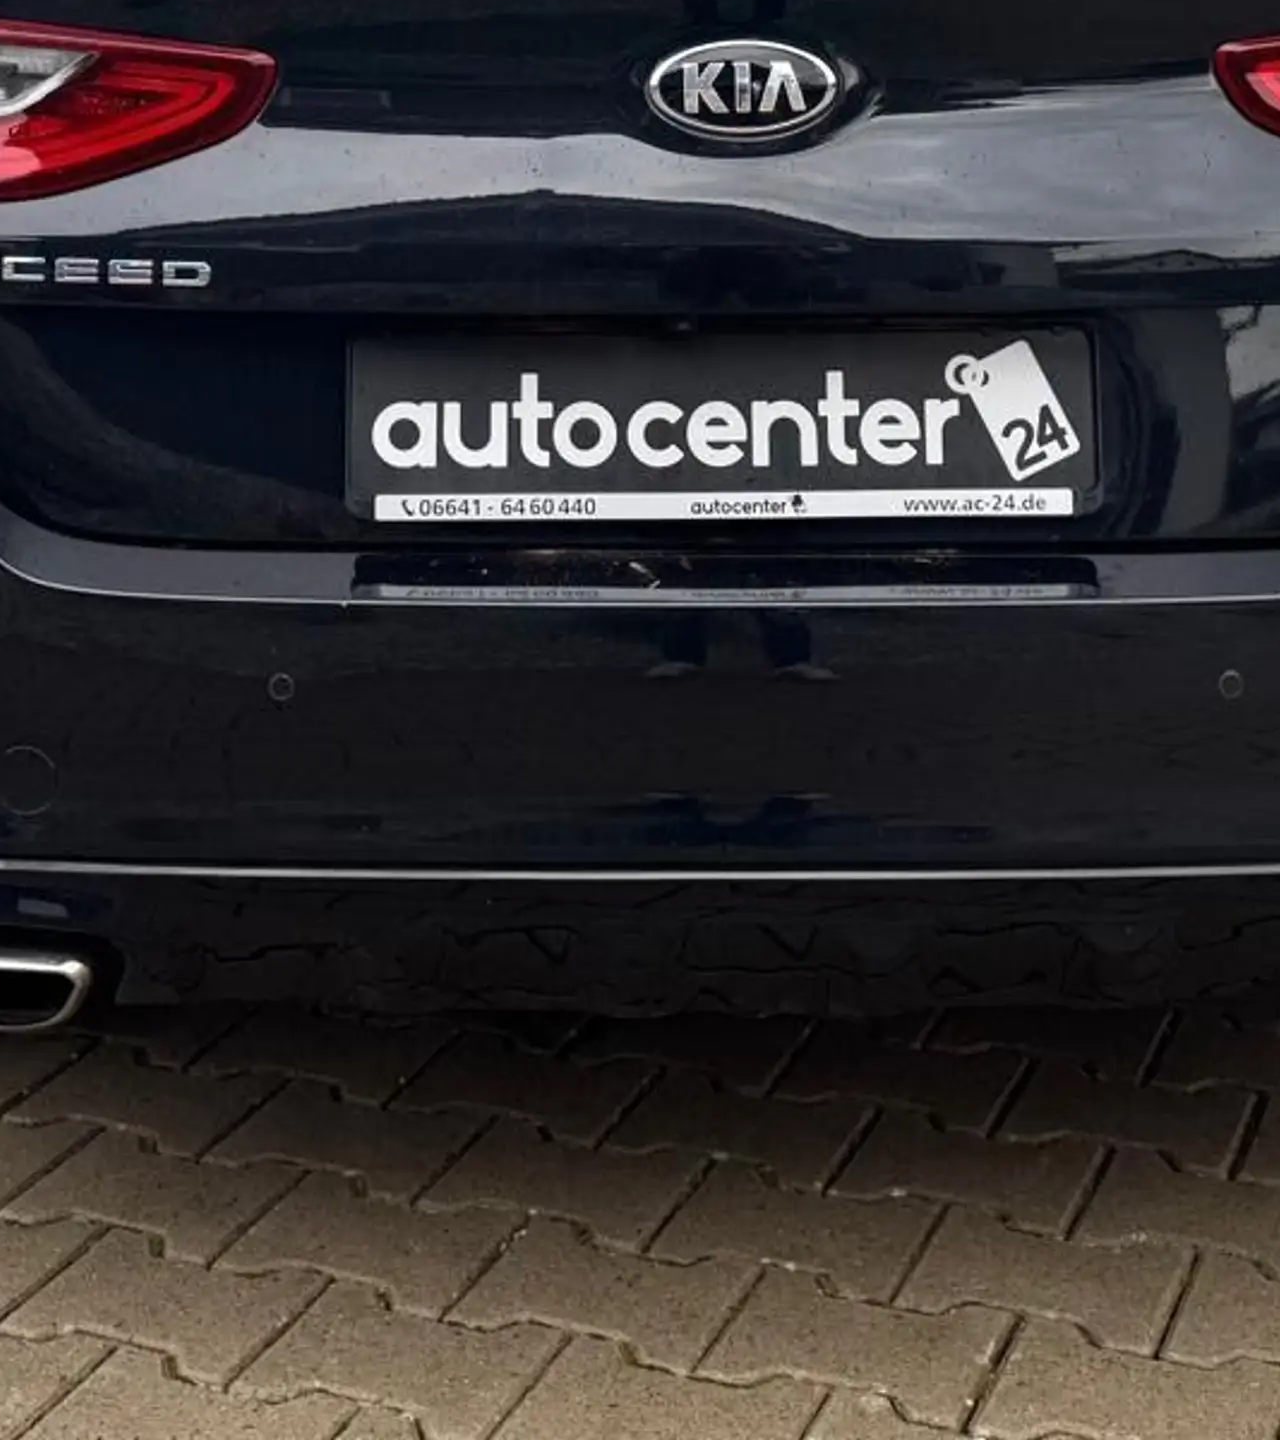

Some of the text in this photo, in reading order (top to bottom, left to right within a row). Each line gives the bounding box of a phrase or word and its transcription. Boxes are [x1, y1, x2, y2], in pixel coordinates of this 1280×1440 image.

[681, 61, 807, 113] KIA
[2, 257, 212, 287] CEED
[1001, 405, 1069, 468] 24
[418, 498, 481, 516] 06641
[690, 498, 787, 516] autocenter
[904, 494, 1047, 513] www.ac-24.de
